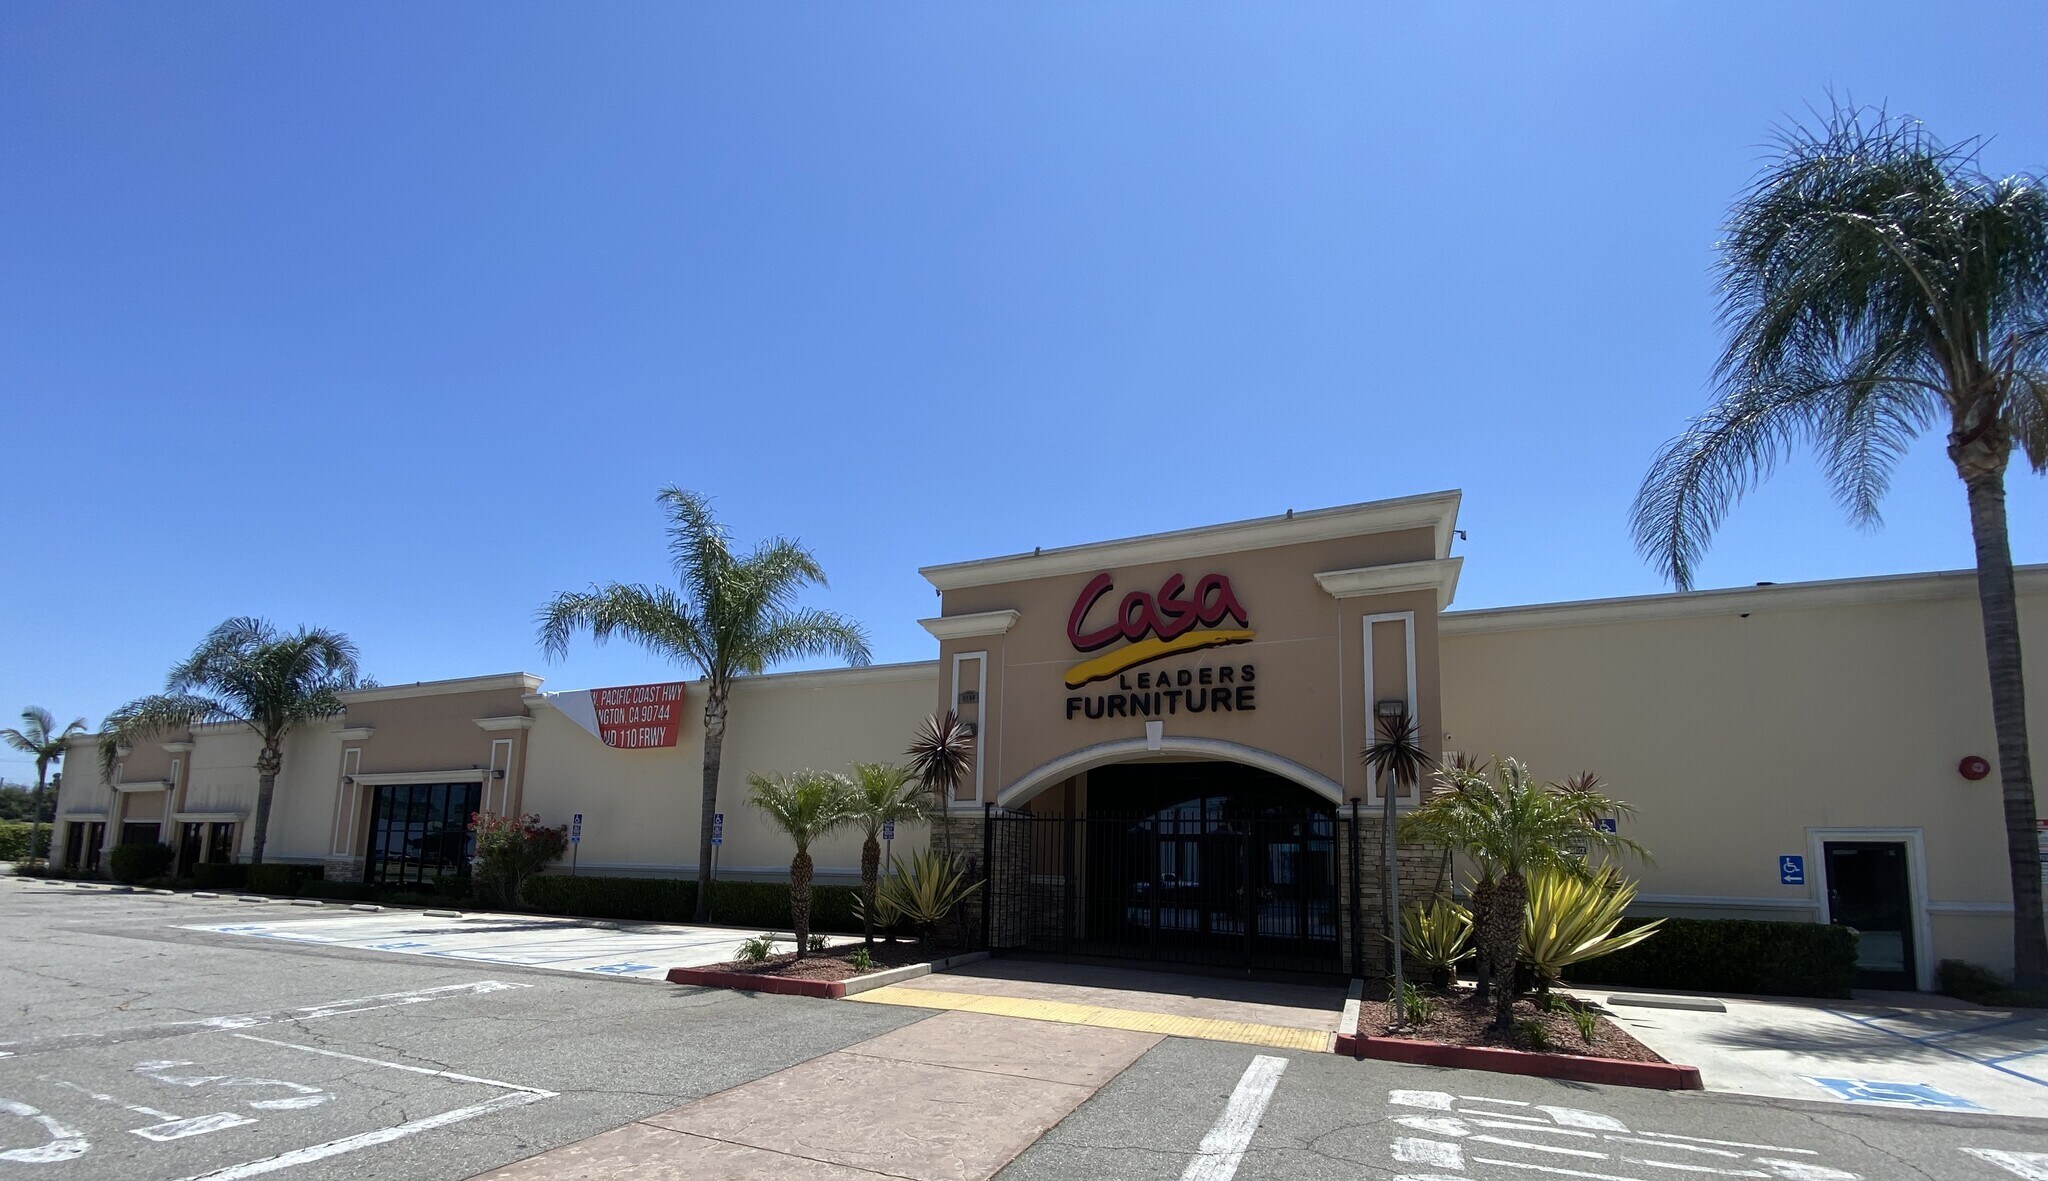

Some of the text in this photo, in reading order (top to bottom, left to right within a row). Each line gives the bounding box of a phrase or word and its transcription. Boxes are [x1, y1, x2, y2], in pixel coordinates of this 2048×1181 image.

[1119, 664, 1256, 690] LEADERS
[601, 688, 631, 706] PACIFIC
[633, 686, 660, 704] COAST
[662, 684, 683, 702] HWY
[1066, 685, 1256, 720] FURNITURE
[597, 704, 670, 725] NGTON, CA 90744
[603, 726, 666, 748] ND 110 FRWY
